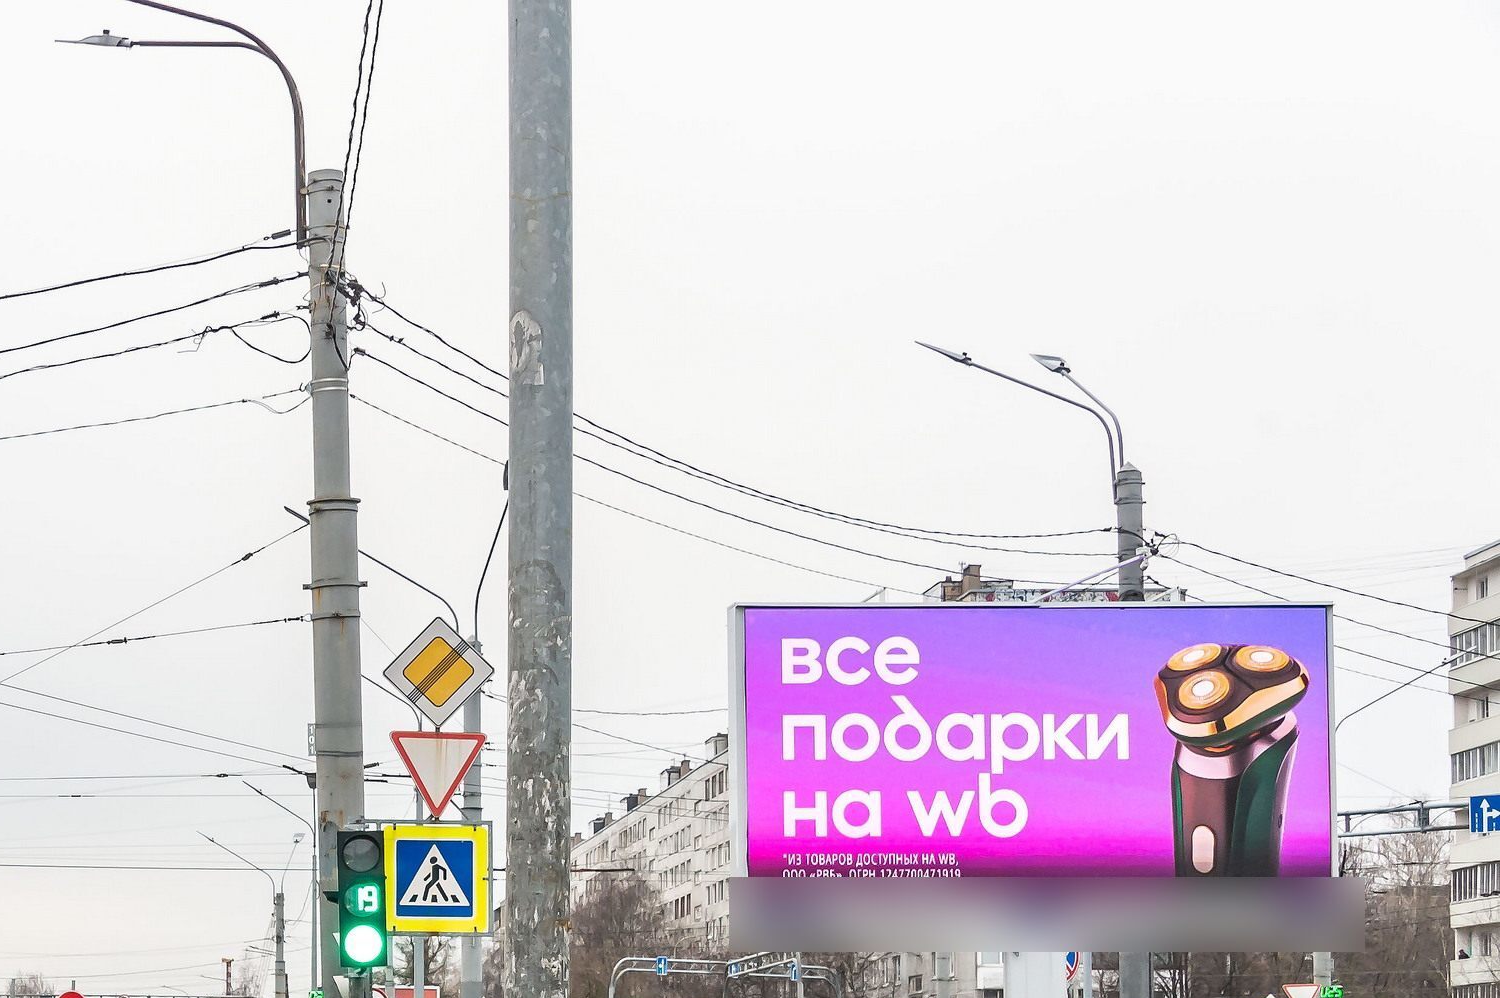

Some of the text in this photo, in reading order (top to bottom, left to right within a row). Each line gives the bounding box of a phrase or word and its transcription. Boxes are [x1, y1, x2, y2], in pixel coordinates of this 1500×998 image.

[782, 636, 920, 686] все
[782, 695, 1130, 775] подарки
[783, 772, 1029, 838] на wb
[806, 853, 853, 866] ТОВАРОВ
[855, 853, 919, 868] ДОСТУПНЫХ
[921, 853, 936, 866] НА
[357, 885, 379, 912] 19
